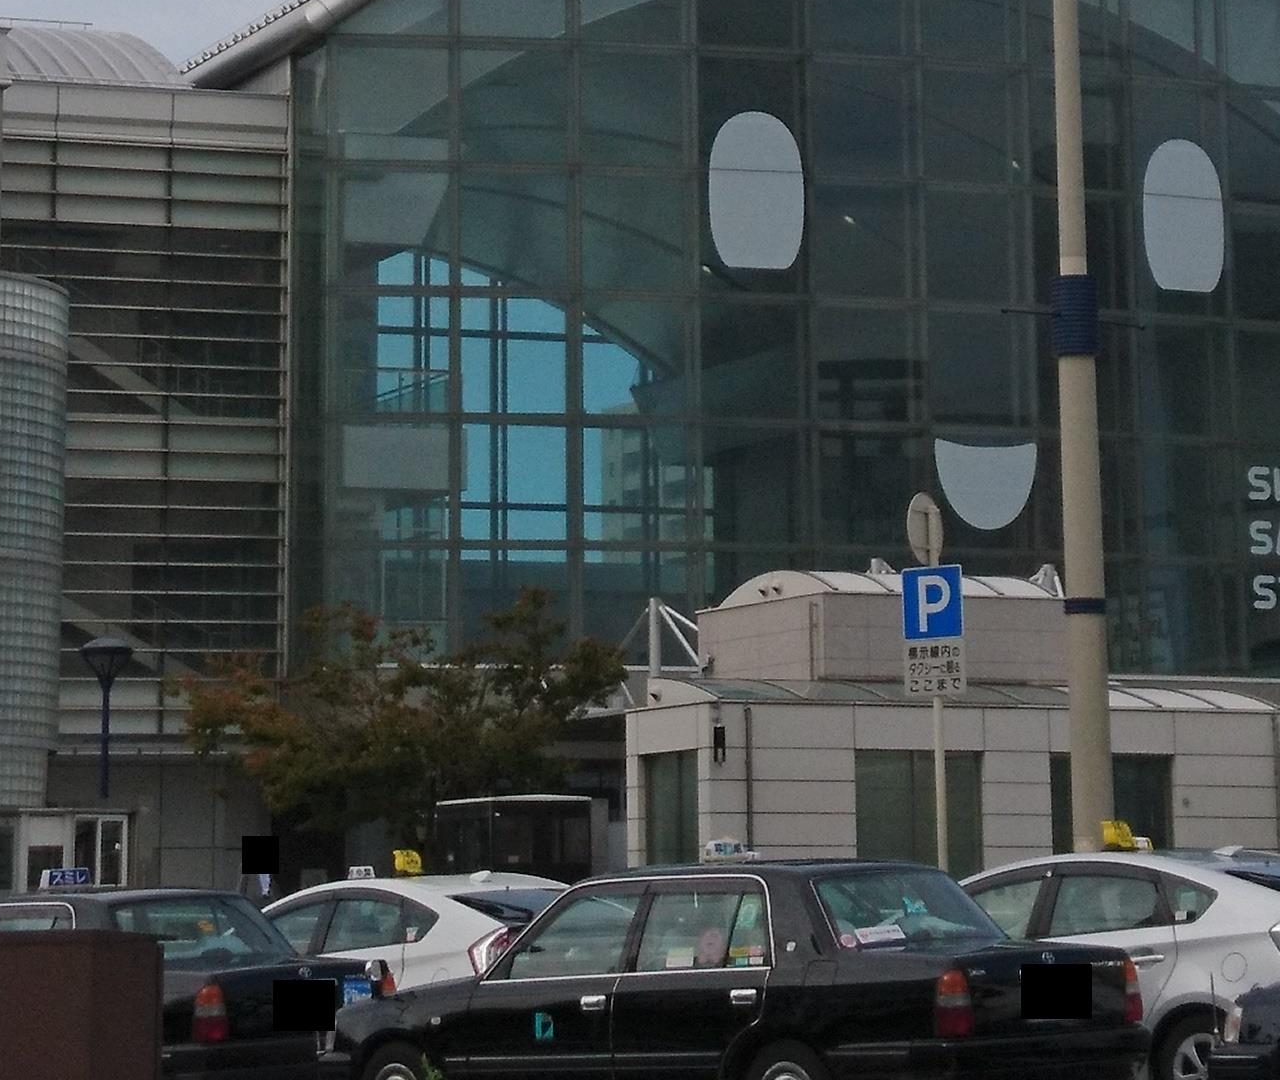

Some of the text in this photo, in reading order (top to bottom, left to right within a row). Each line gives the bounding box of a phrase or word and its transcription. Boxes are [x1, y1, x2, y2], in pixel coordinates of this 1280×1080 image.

[917, 575, 951, 633] P
[910, 677, 961, 693] ここまで
[52, 871, 86, 885] スミレ
